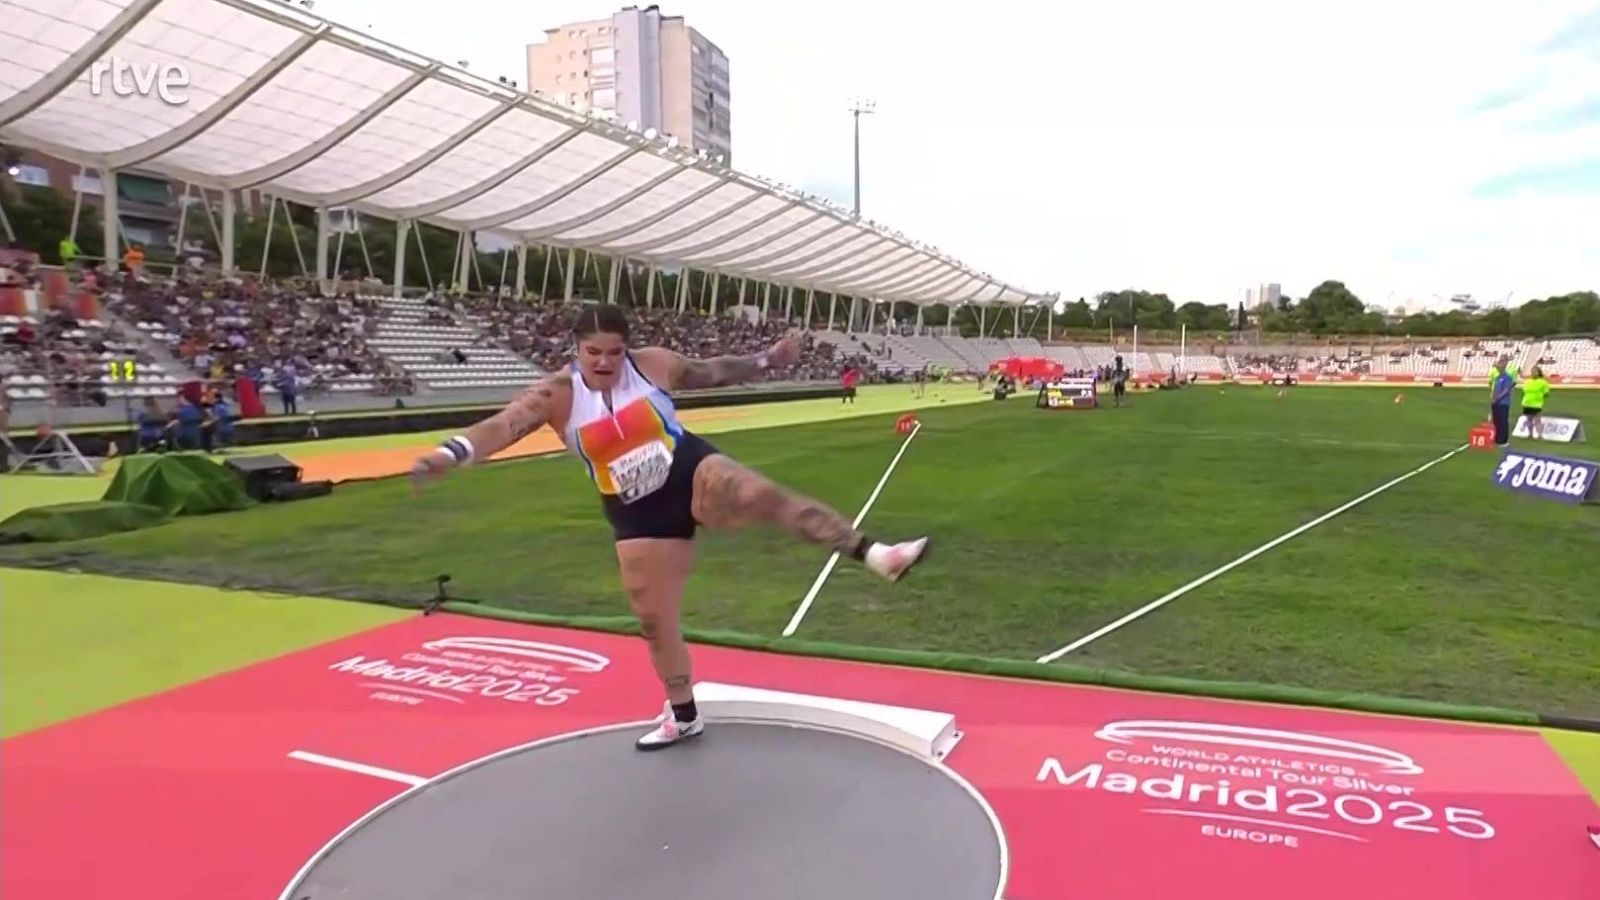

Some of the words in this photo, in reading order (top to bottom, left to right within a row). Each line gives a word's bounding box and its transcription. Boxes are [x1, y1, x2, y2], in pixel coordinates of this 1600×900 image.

[327, 655, 581, 706] Madrid2025
[1105, 749, 1262, 778] Continental
[1266, 767, 1328, 787] Tour
[1332, 775, 1415, 796] Silver
[1152, 743, 1230, 762] WORLD
[1036, 757, 1496, 841] Madrid2025
[1201, 824, 1299, 848] EUROPE
